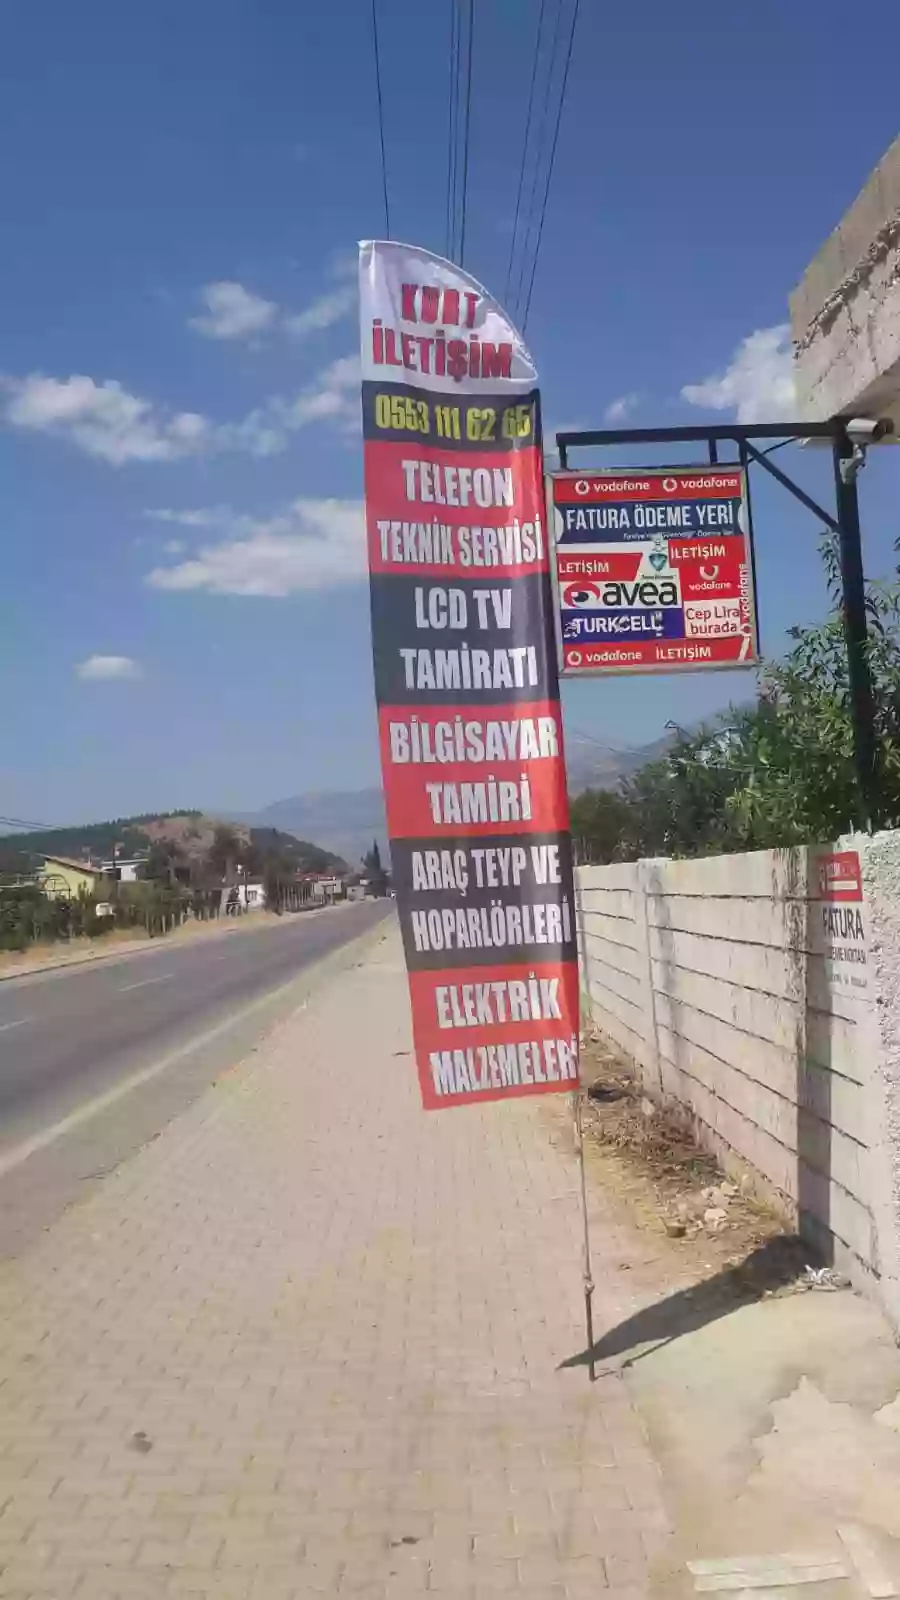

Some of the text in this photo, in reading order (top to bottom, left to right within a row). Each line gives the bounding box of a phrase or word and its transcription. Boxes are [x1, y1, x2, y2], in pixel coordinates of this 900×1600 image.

[372, 319, 513, 383] İLETİŞİM
[375, 394, 531, 441] 0553 111 62 65
[401, 459, 514, 508] TELEFON
[593, 480, 650, 493] vodafone
[681, 477, 738, 489] vodafone
[566, 500, 733, 531] FATURA ÖDEME YERİ
[377, 513, 544, 567] TEKNİK SERVİSİ
[602, 582, 678, 606] avea
[689, 580, 732, 591] vodafone
[414, 586, 512, 630] LCD TV
[572, 615, 661, 634] TURKCELL
[686, 606, 740, 622] Cep Lira
[690, 621, 738, 635] burada
[400, 641, 538, 689] TAMİRATI
[586, 650, 642, 662] vodafone
[389, 714, 559, 764] BİLGİSAYAR
[425, 772, 532, 824] TAMİRİ
[411, 845, 562, 897] ARAÇ TEYP VE
[411, 895, 572, 952] HOPARLÖRLERİ
[822, 907, 865, 940] FATURA
[435, 971, 562, 1029] ELEKTRİK
